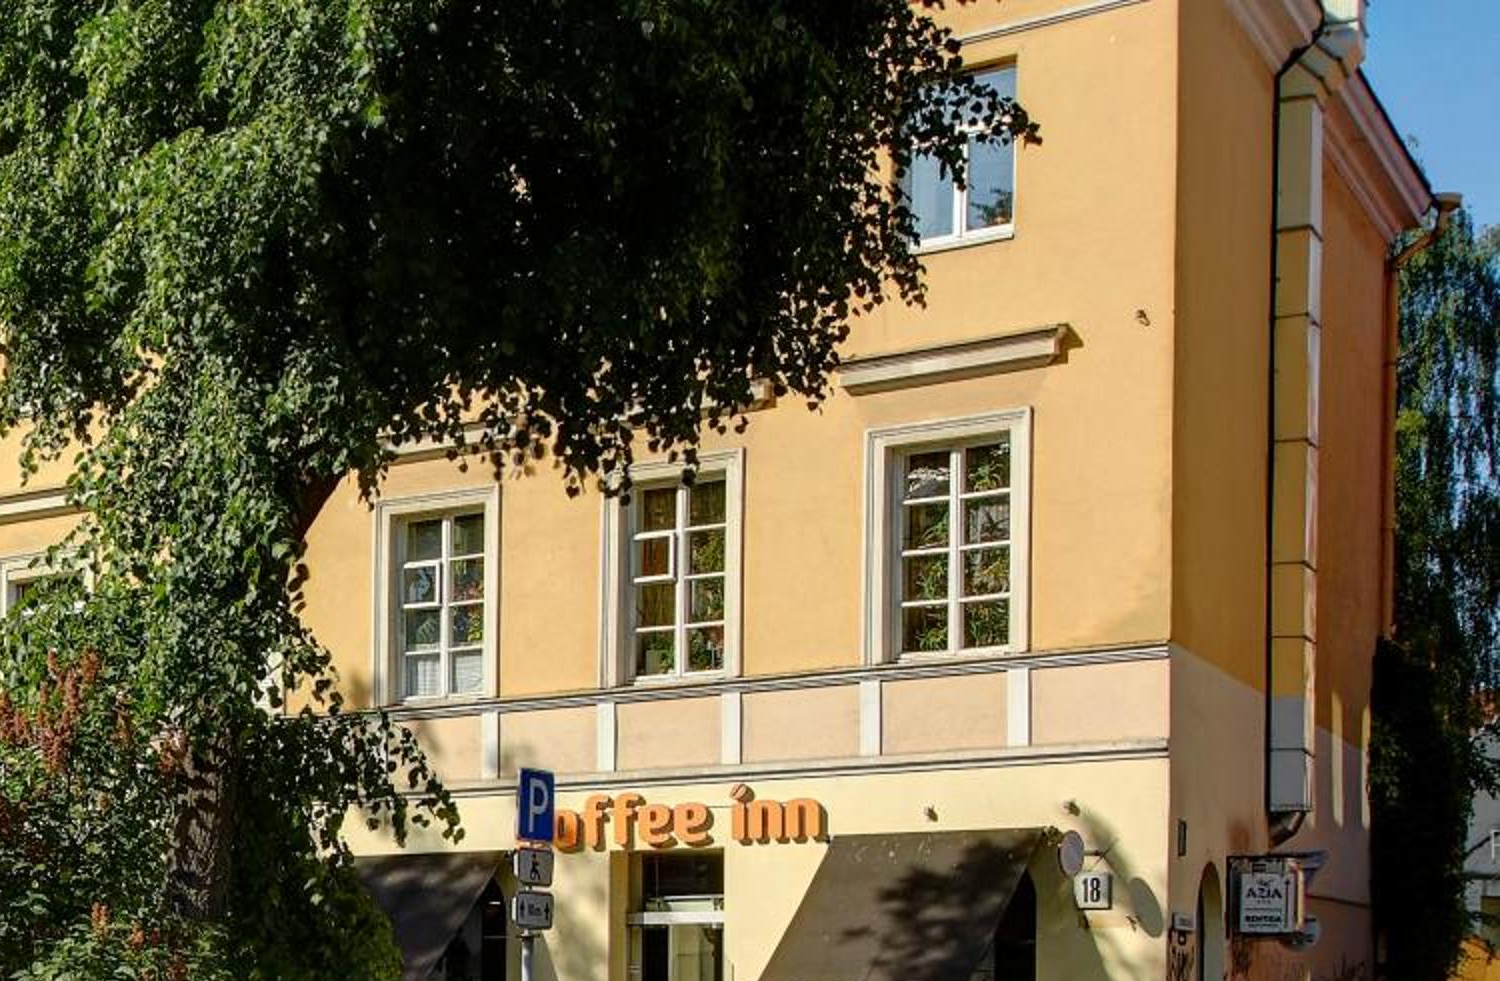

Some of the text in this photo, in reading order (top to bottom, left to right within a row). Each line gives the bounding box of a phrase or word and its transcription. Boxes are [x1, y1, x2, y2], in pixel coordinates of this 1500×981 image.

[516, 783, 828, 852] offee inn
[529, 778, 549, 833] P
[1082, 877, 1101, 903] 18
